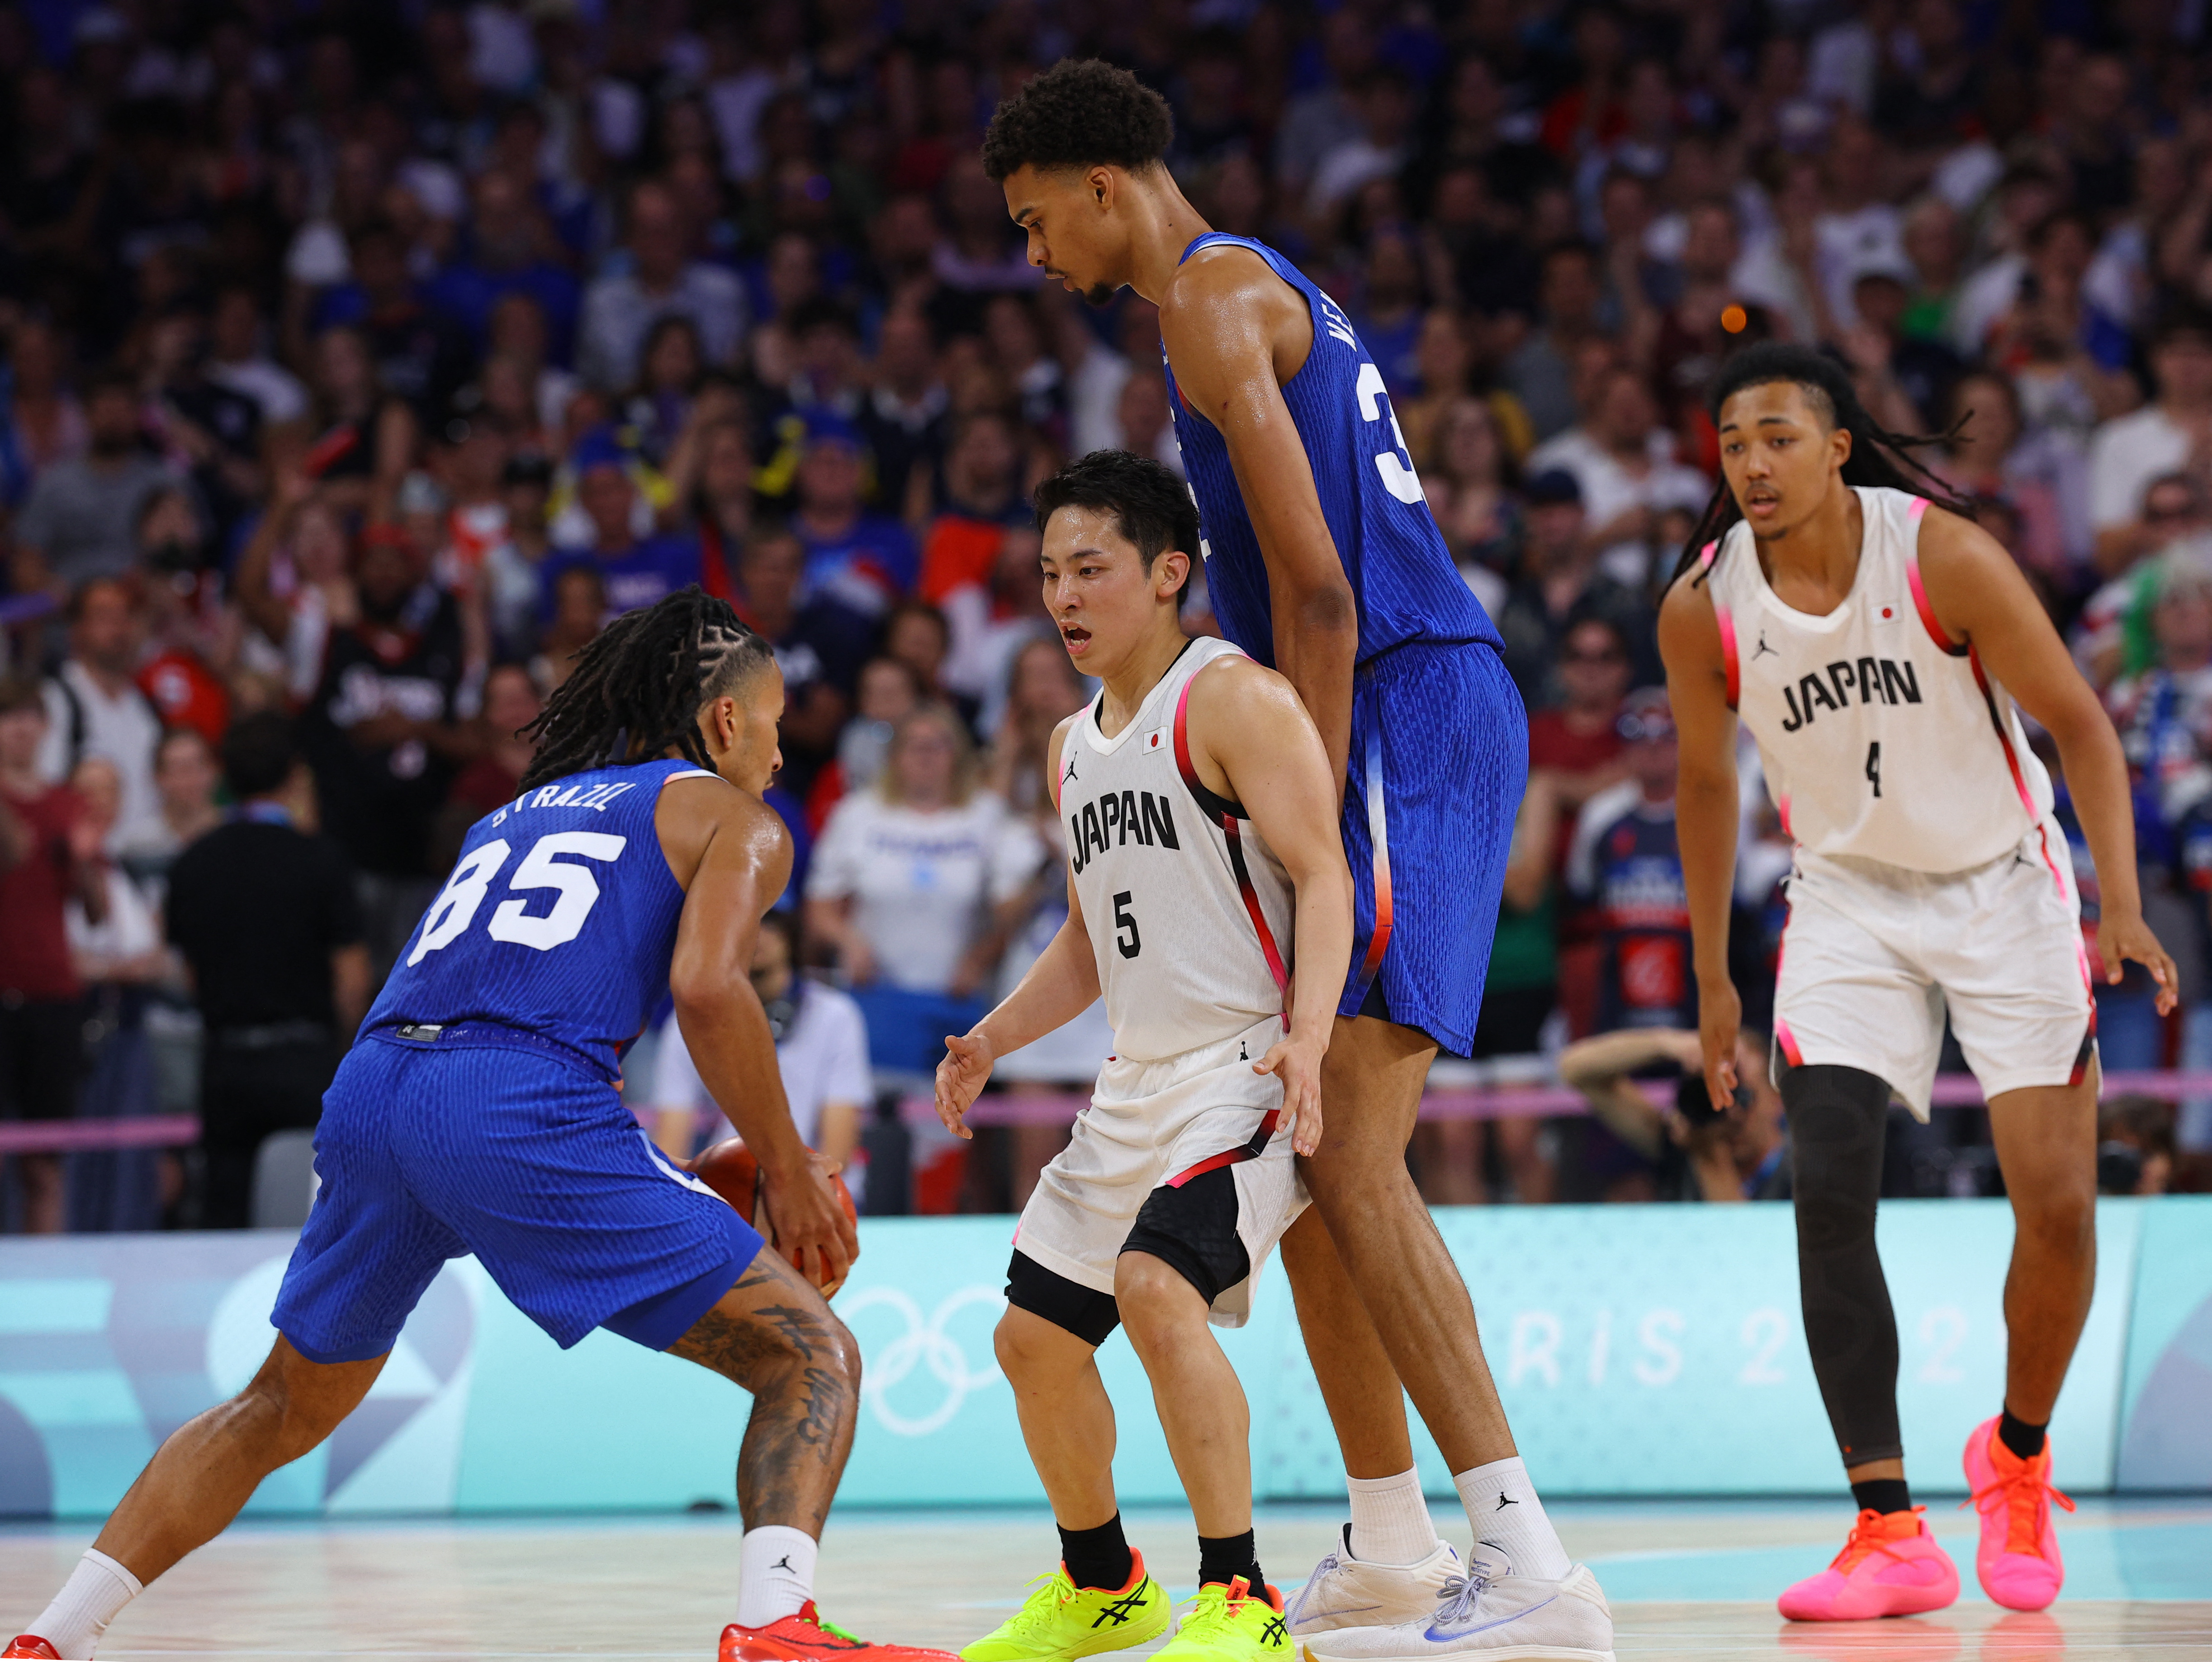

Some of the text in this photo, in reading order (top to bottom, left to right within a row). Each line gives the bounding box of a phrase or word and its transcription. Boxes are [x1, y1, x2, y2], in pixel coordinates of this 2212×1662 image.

[1356, 363, 1430, 511] 3
[1782, 657, 1922, 731] JAPAN
[1866, 741, 1881, 798] 4
[1072, 790, 1180, 875] JAPAN
[407, 831, 627, 968] 85
[1113, 890, 1141, 959] 5
[1505, 1306, 2007, 1388] RIS 22
[1471, 1566, 1491, 1577] PROTOTYPE
